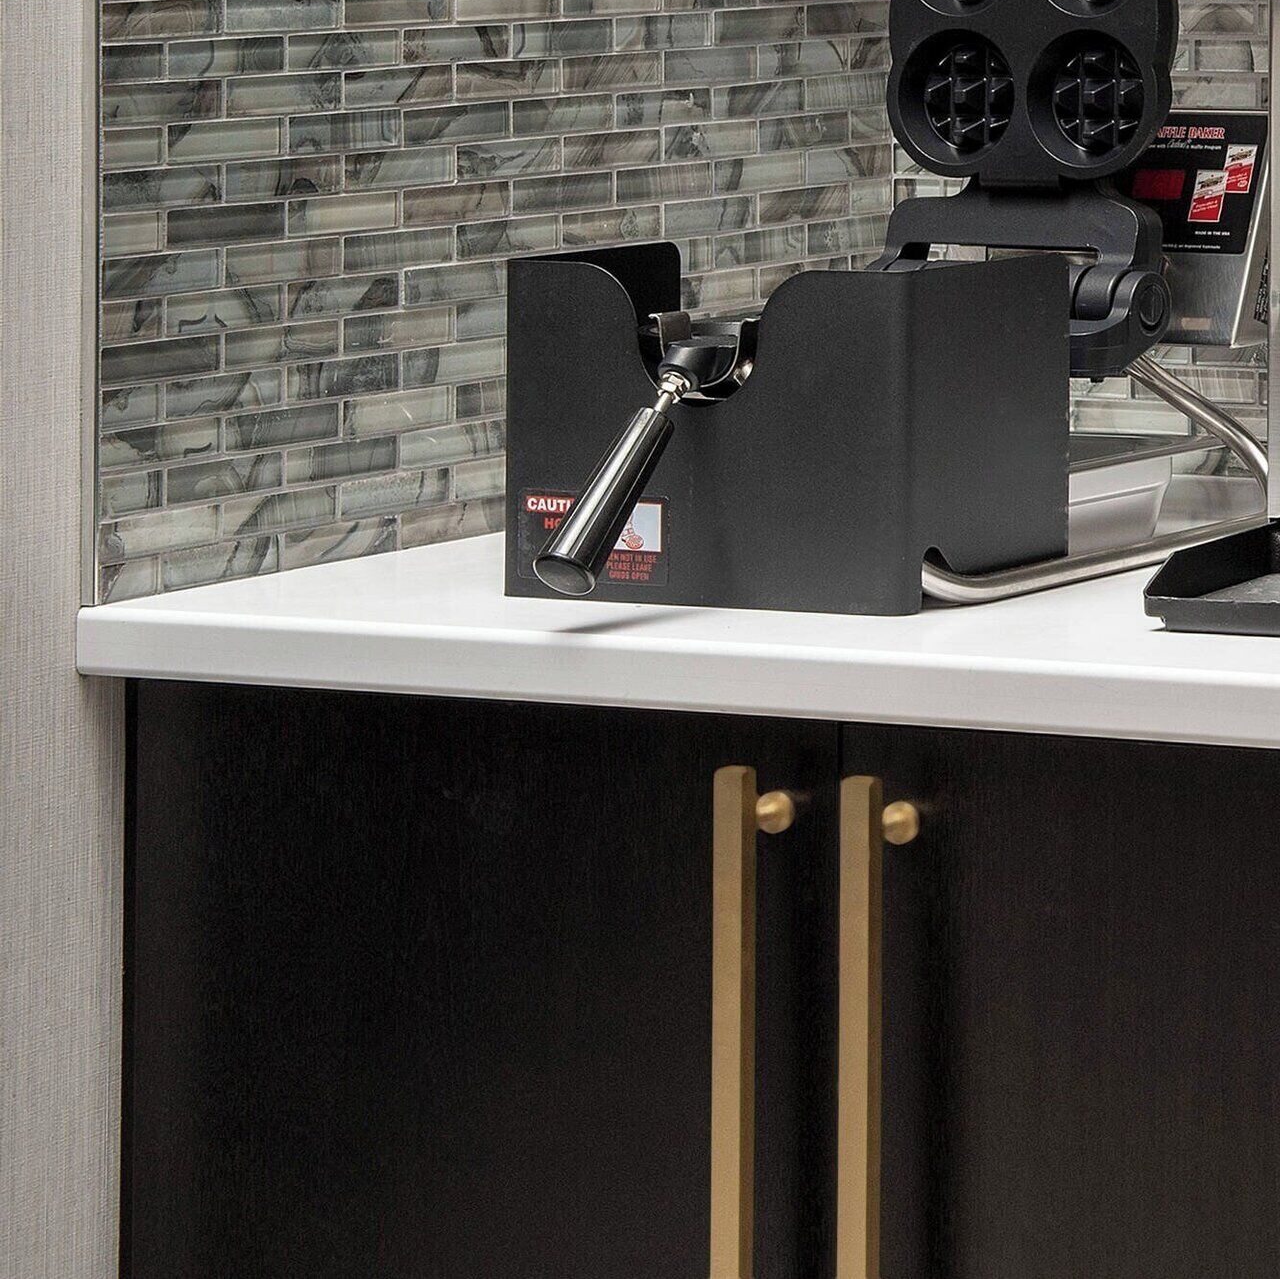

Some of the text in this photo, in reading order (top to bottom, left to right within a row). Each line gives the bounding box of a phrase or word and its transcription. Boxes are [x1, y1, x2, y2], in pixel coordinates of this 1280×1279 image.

[1157, 126, 1225, 139] AFFLE BAKER
[527, 497, 571, 512] CAUTI
